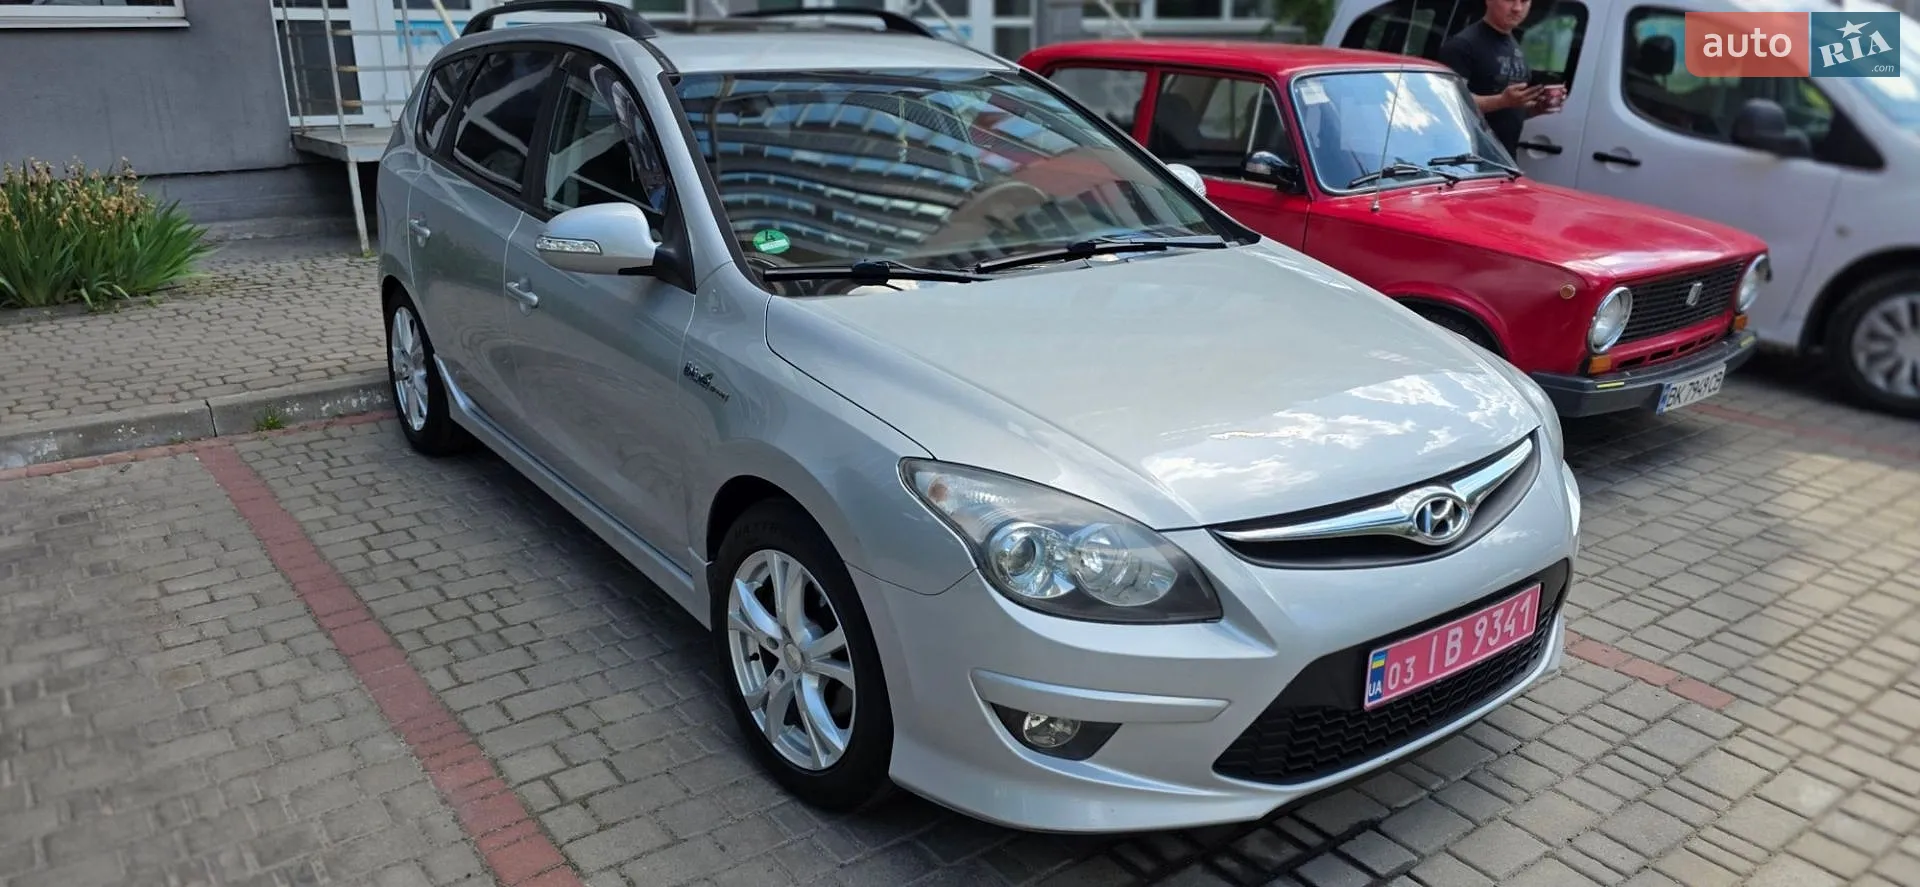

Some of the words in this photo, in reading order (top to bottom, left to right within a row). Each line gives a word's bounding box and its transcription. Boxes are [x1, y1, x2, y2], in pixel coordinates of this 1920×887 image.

[1666, 384, 1685, 407] BK
[1387, 655, 1416, 690] 03
[1428, 625, 1464, 674] IB
[1472, 593, 1532, 656] 9341
[1368, 681, 1383, 696] UA
